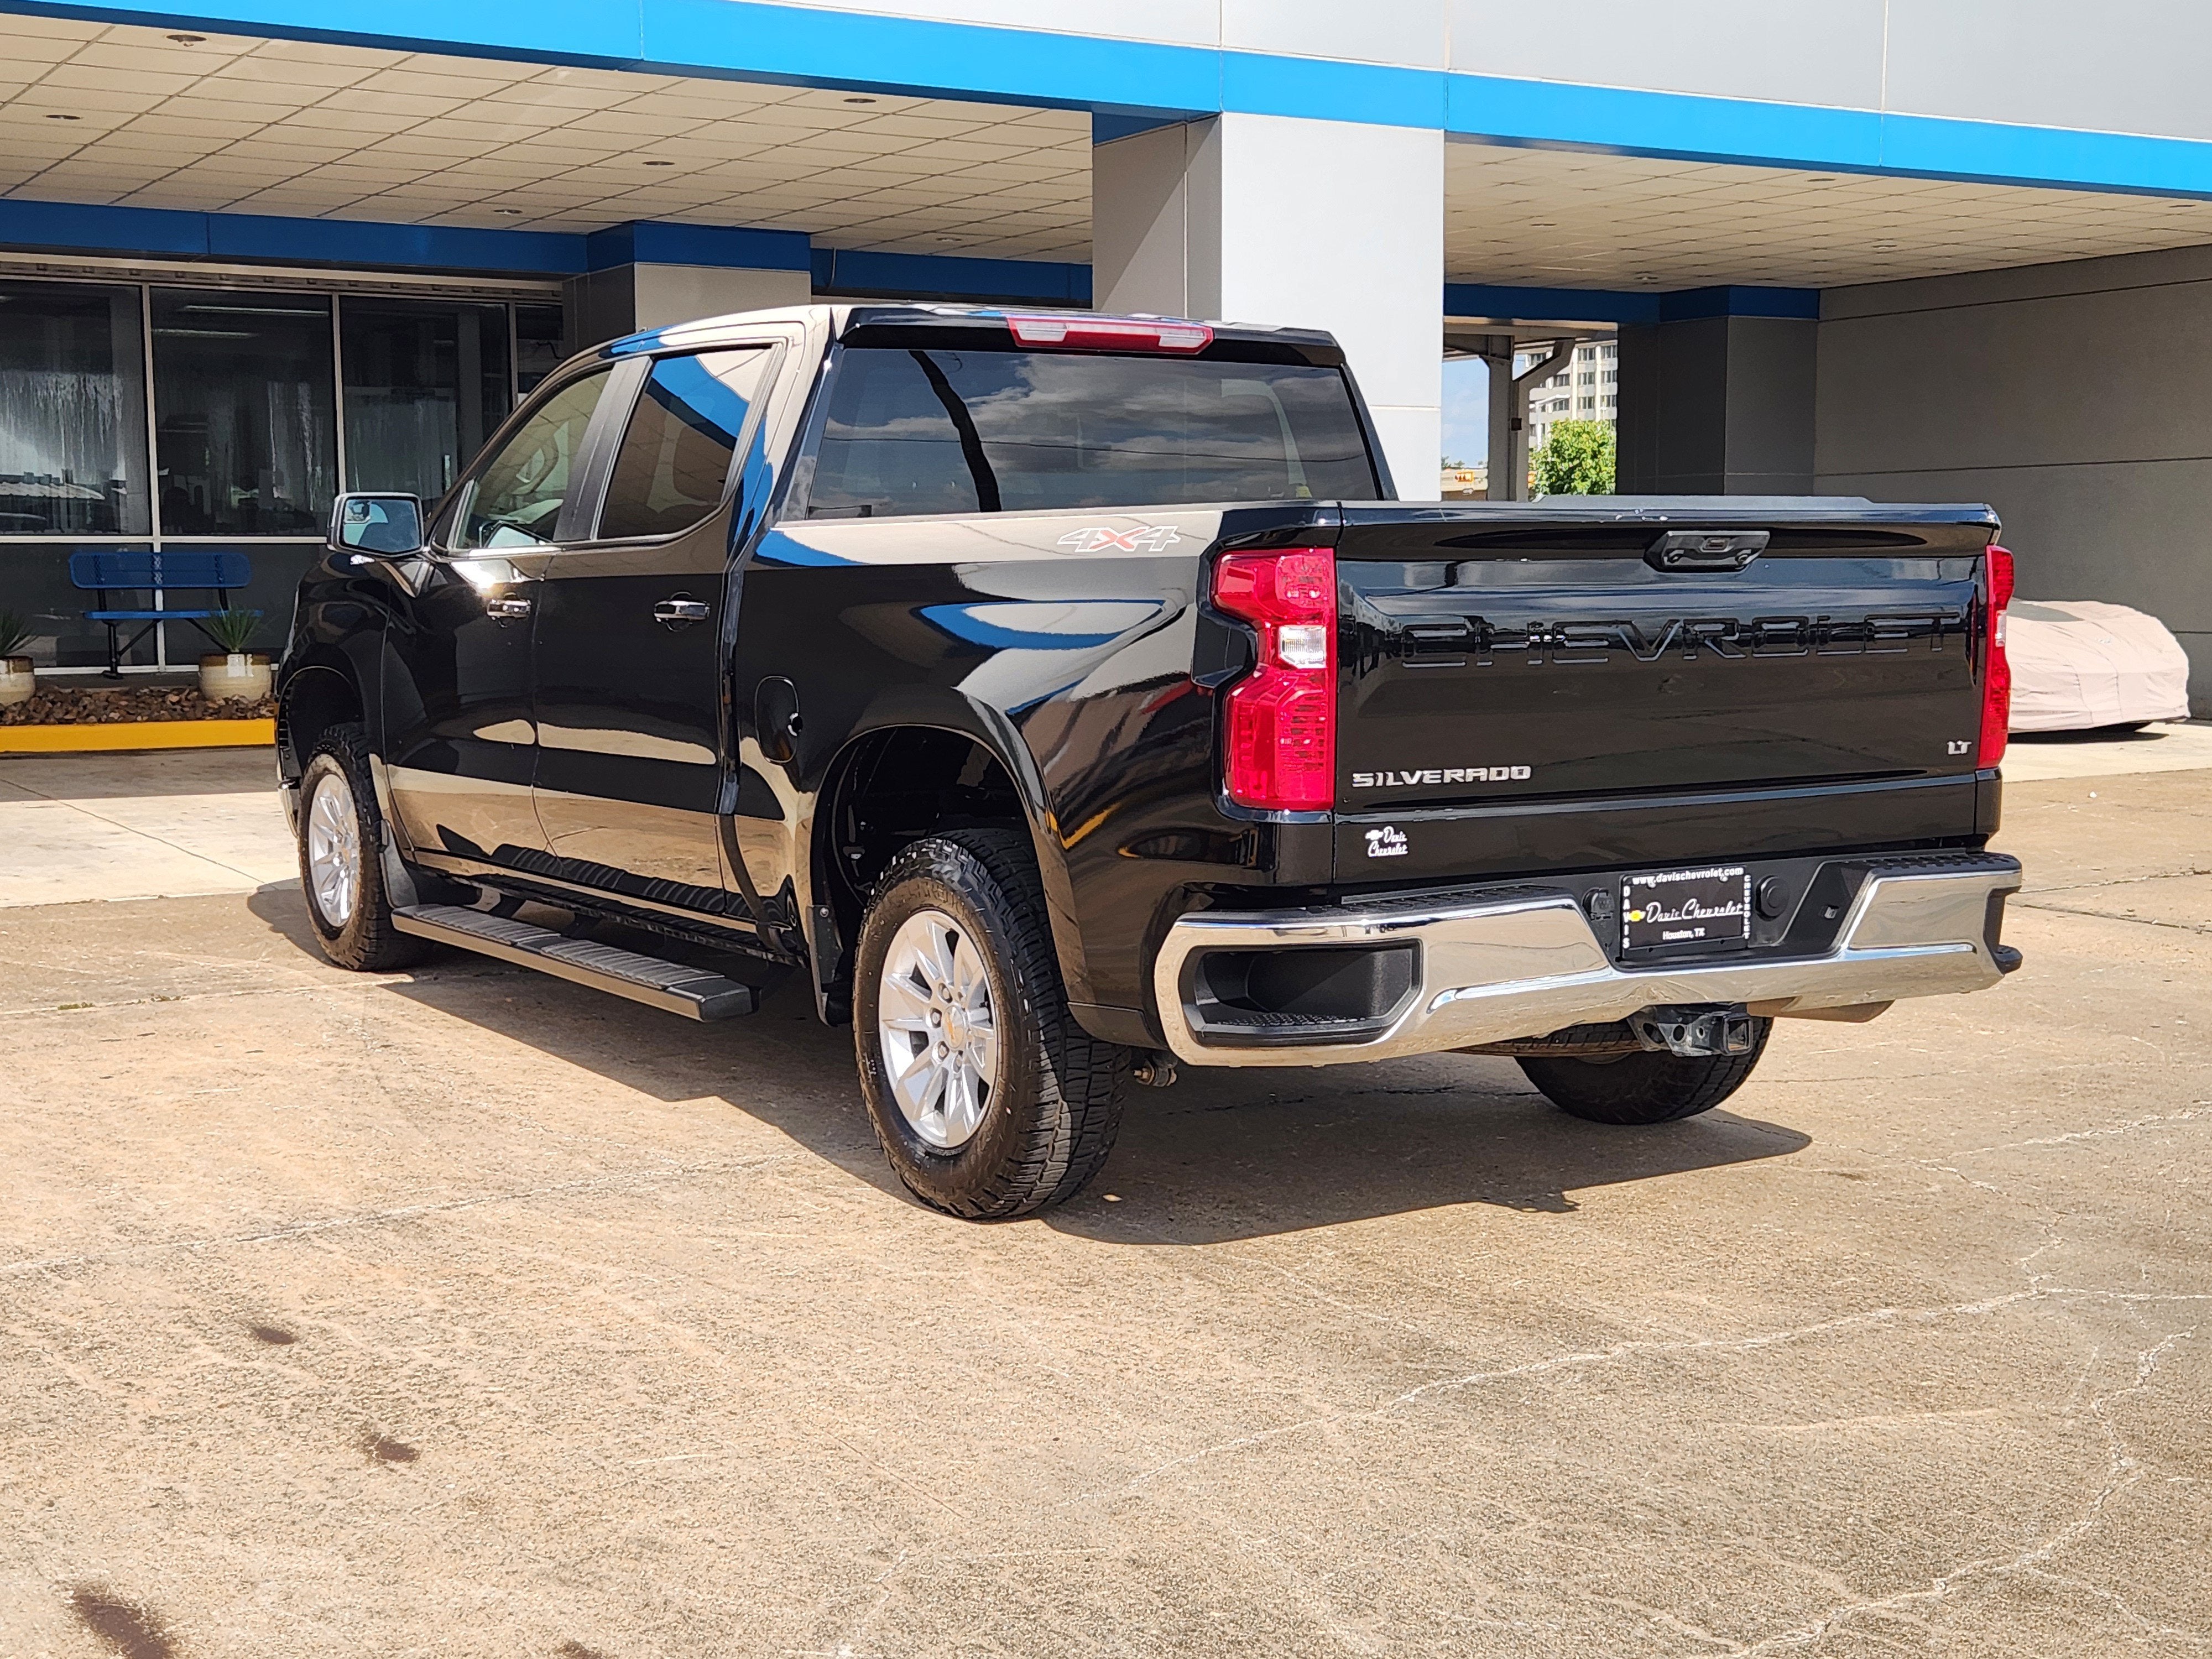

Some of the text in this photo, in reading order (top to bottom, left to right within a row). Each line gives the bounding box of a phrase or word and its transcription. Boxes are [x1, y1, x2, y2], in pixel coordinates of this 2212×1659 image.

[1401, 611, 1963, 669] CHEVROLET
[1947, 740, 1972, 755] LT
[1352, 765, 1531, 787] SILVERADO
[1383, 826, 1407, 843] Davis
[1368, 841, 1408, 857] Chevrolet
[1632, 867, 1744, 886] www.davischevrolet.com
[1623, 885, 1631, 949] DAVIS
[1646, 898, 1744, 923] Davis Chevrolet
[1663, 927, 1706, 941] Houston, TX
